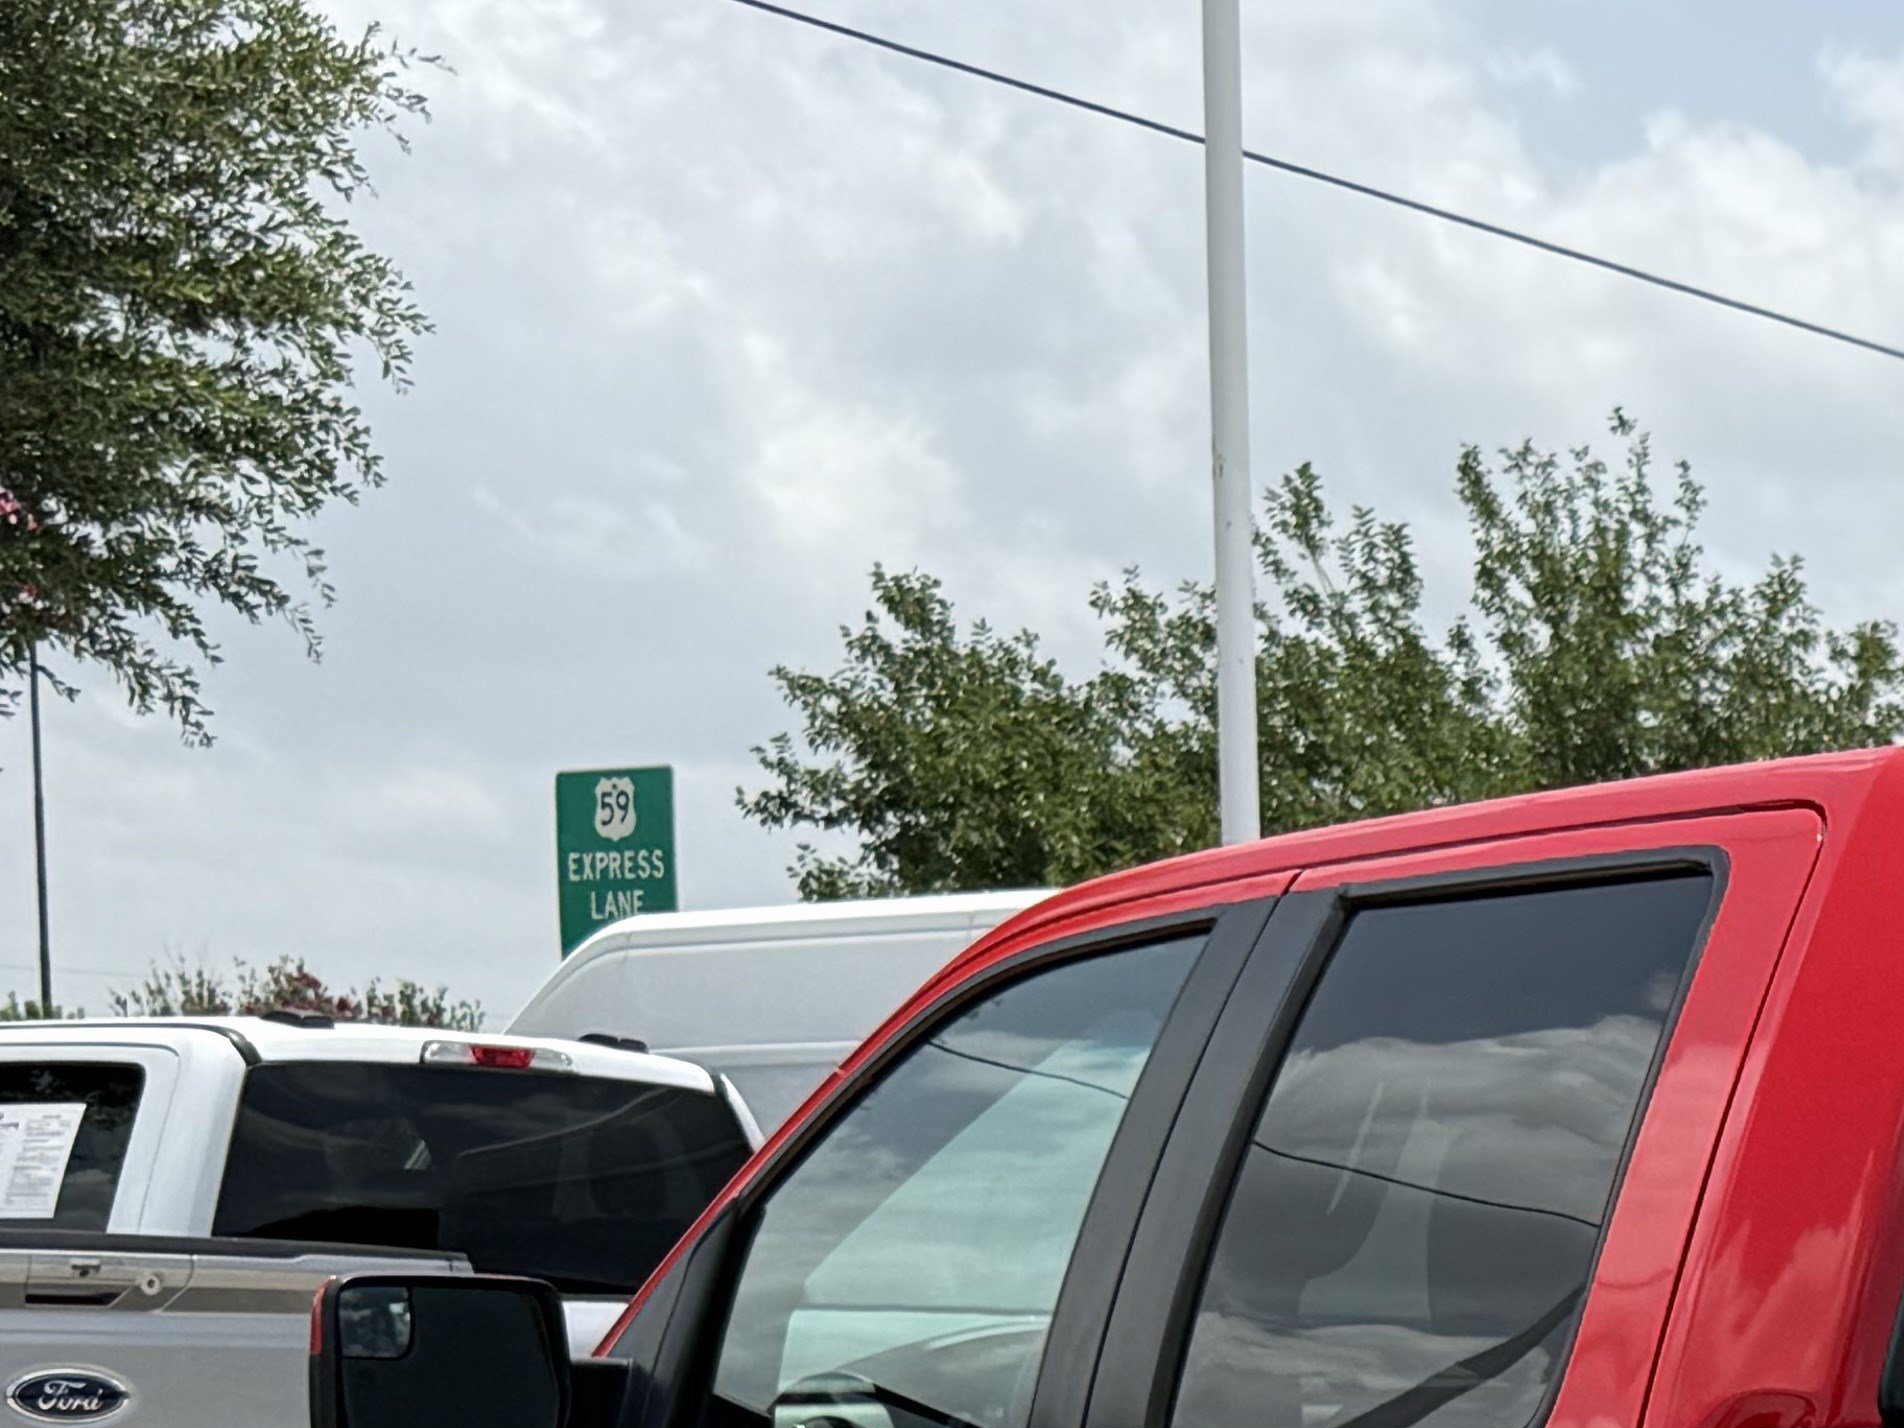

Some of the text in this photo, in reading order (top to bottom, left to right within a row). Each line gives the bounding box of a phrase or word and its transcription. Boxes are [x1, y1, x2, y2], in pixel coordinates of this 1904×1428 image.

[601, 790, 630, 827] 59
[567, 849, 665, 882] EXPRESS
[590, 888, 644, 920] LANE
[37, 1380, 103, 1411] Ford
